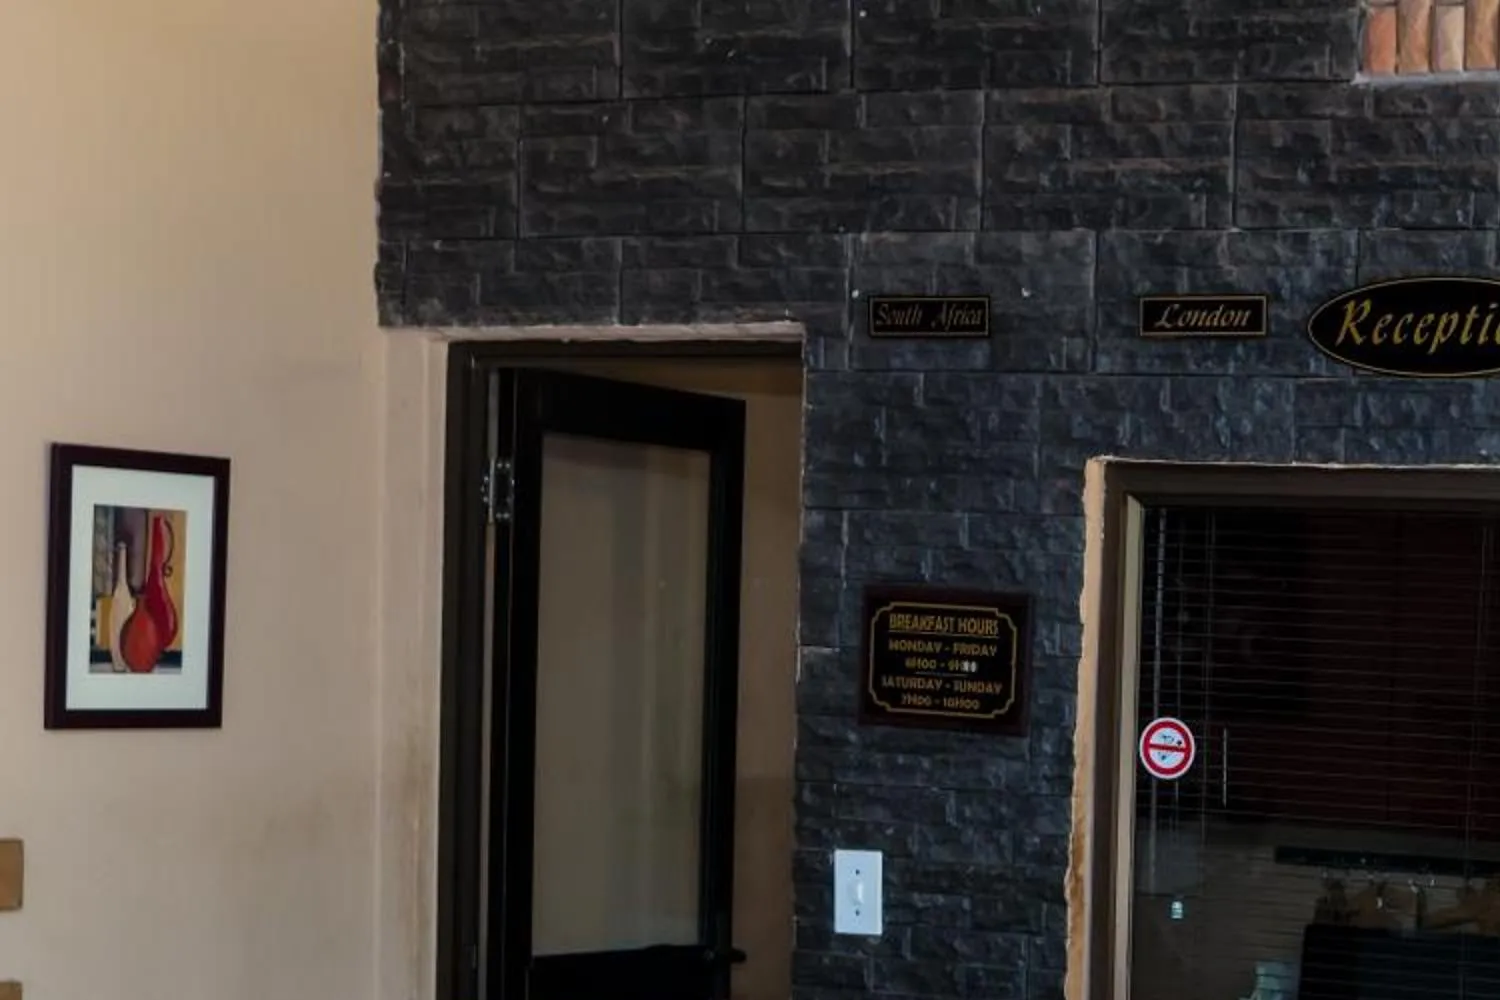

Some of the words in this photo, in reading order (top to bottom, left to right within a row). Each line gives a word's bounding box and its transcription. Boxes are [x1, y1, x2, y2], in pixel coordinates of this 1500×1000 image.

[874, 303, 923, 327] South
[931, 303, 983, 332] Africa
[1154, 304, 1252, 329] London
[889, 613, 955, 632] BREAKFAST
[957, 617, 999, 636] HOURS
[888, 638, 943, 653] MONDAY
[953, 642, 997, 657] FRIDAY
[881, 675, 943, 691] SATURDAY
[953, 680, 1003, 696] SUNDAY
